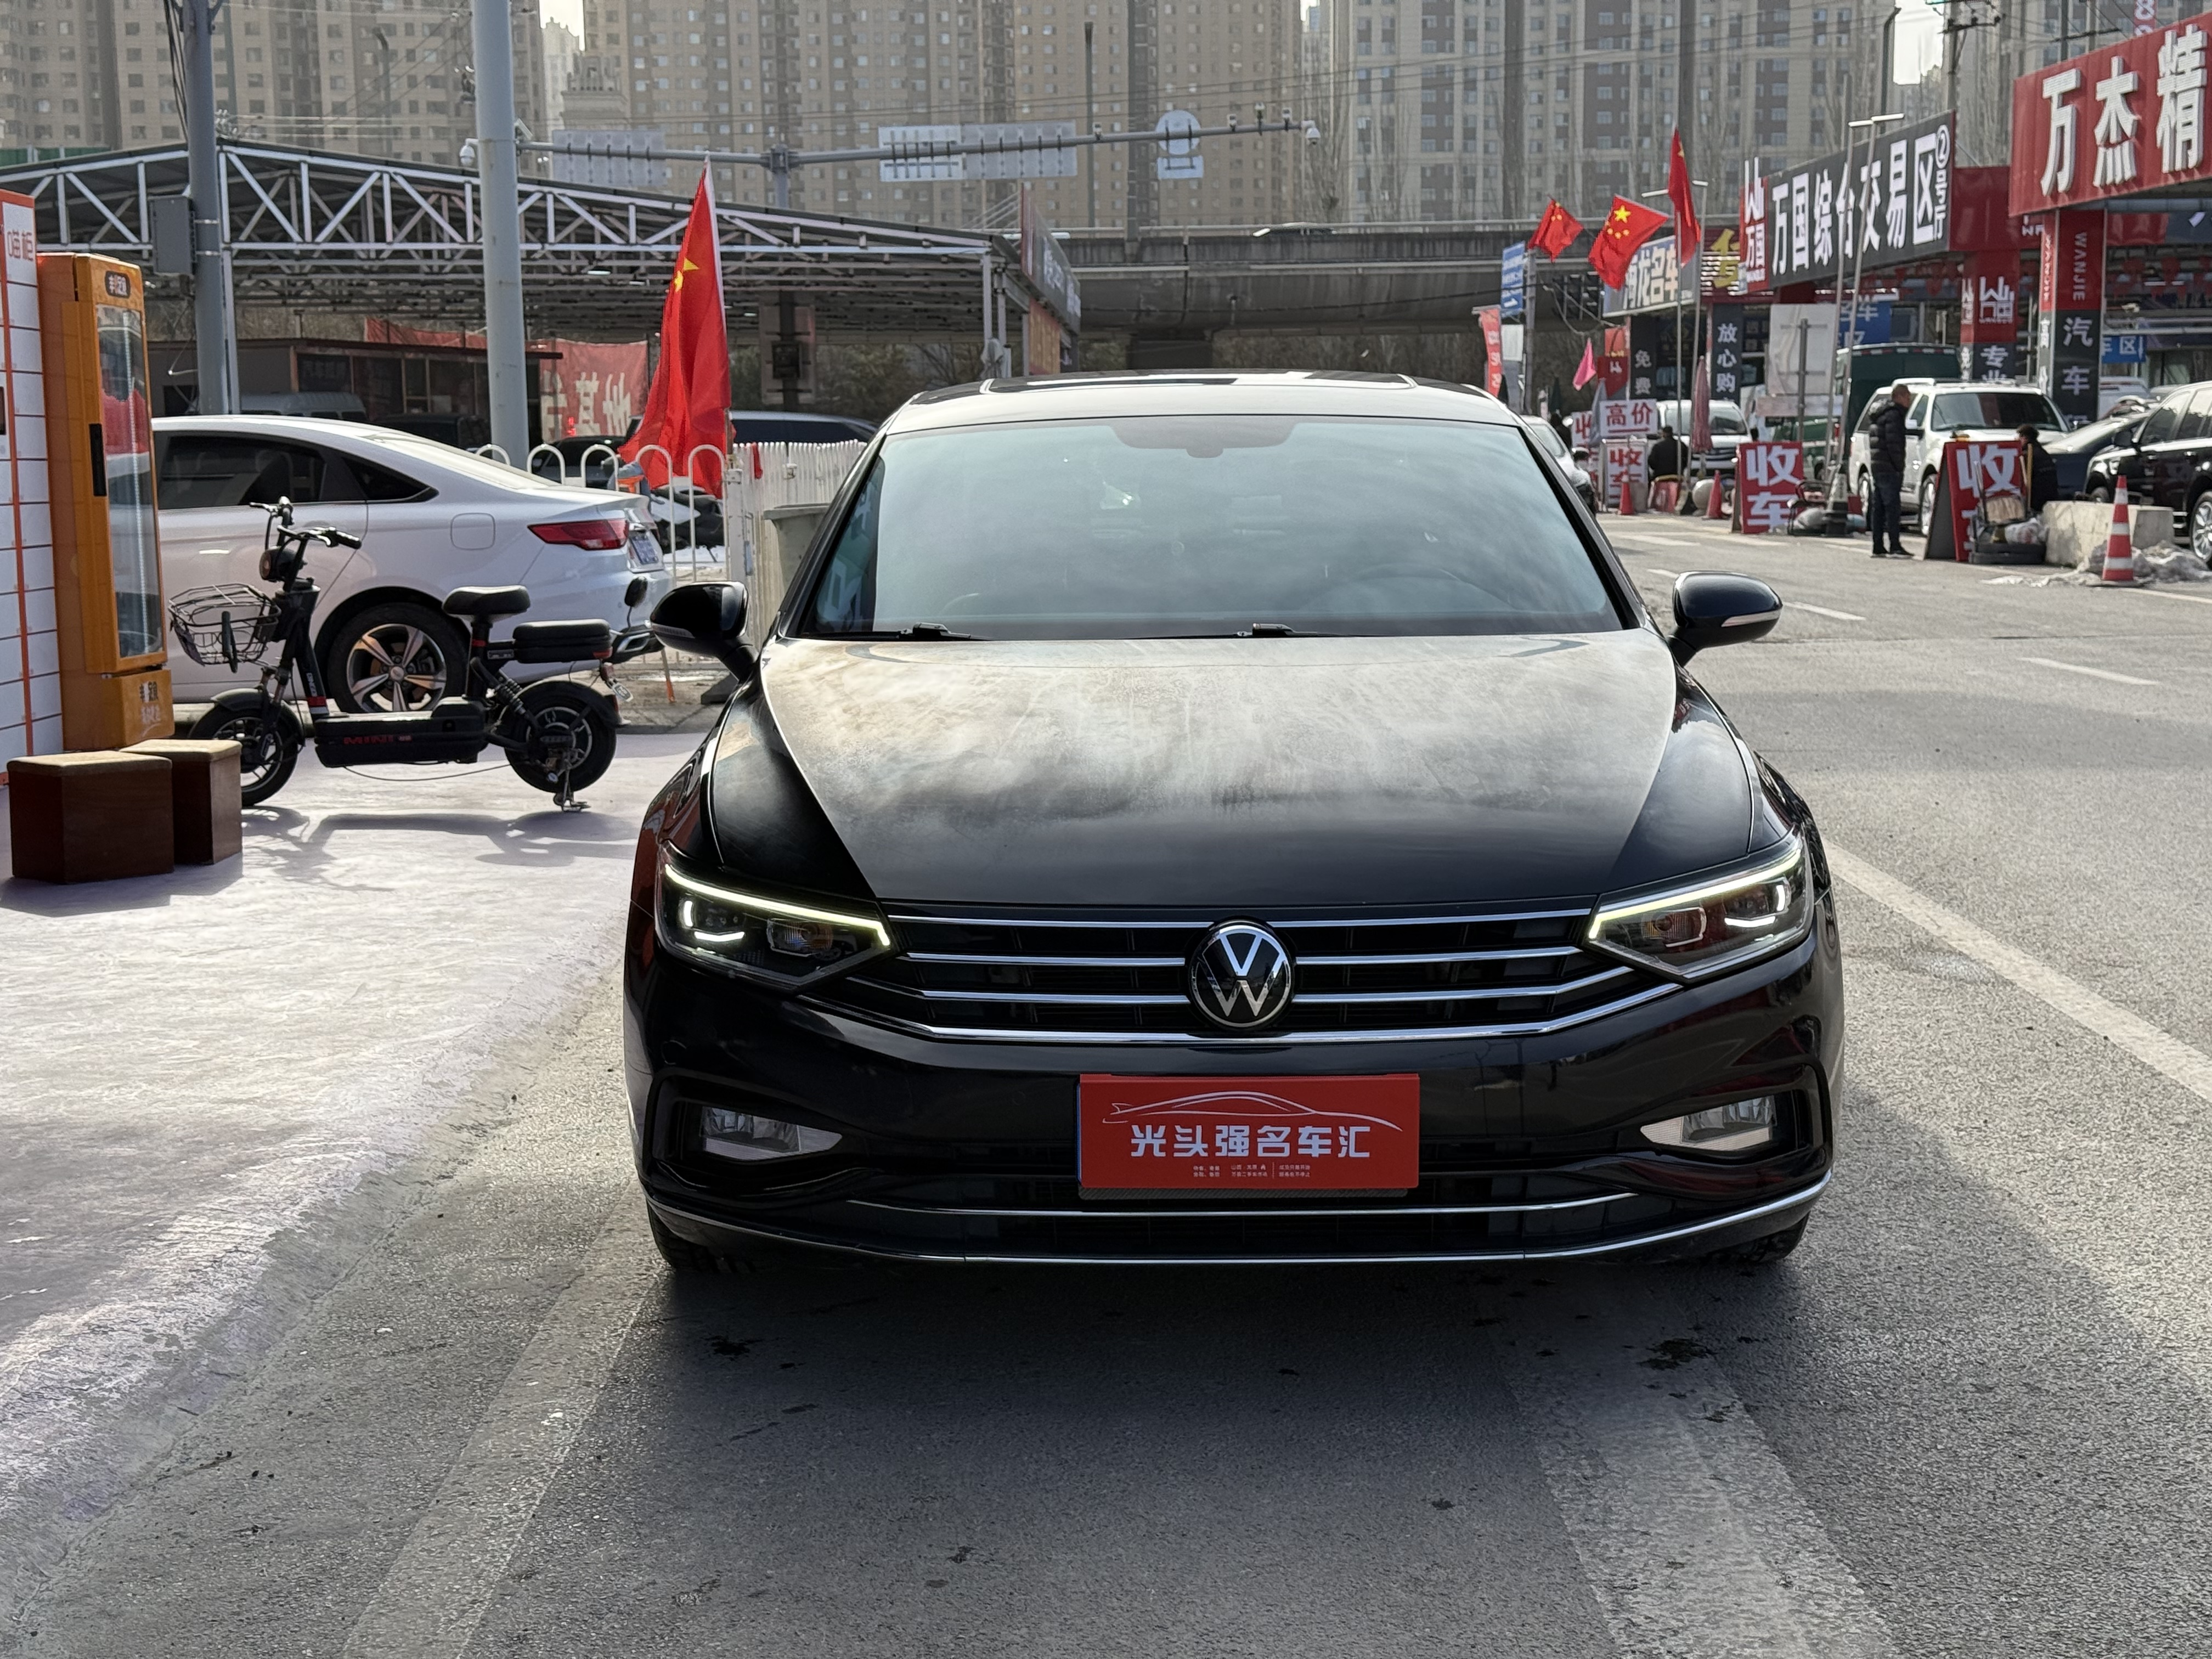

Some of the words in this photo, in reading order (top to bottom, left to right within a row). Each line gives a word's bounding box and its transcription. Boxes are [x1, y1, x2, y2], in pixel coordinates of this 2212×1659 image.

[2040, 23, 2208, 196] 万杰精
[1772, 133, 1937, 275] 万国综合交易区
[2073, 232, 2087, 301] WANJIE
[1716, 323, 1738, 402] 放心购
[1605, 402, 1653, 427] 高价
[1745, 445, 1798, 533] 收车
[1130, 1124, 1371, 1158] 光头强名车汇
